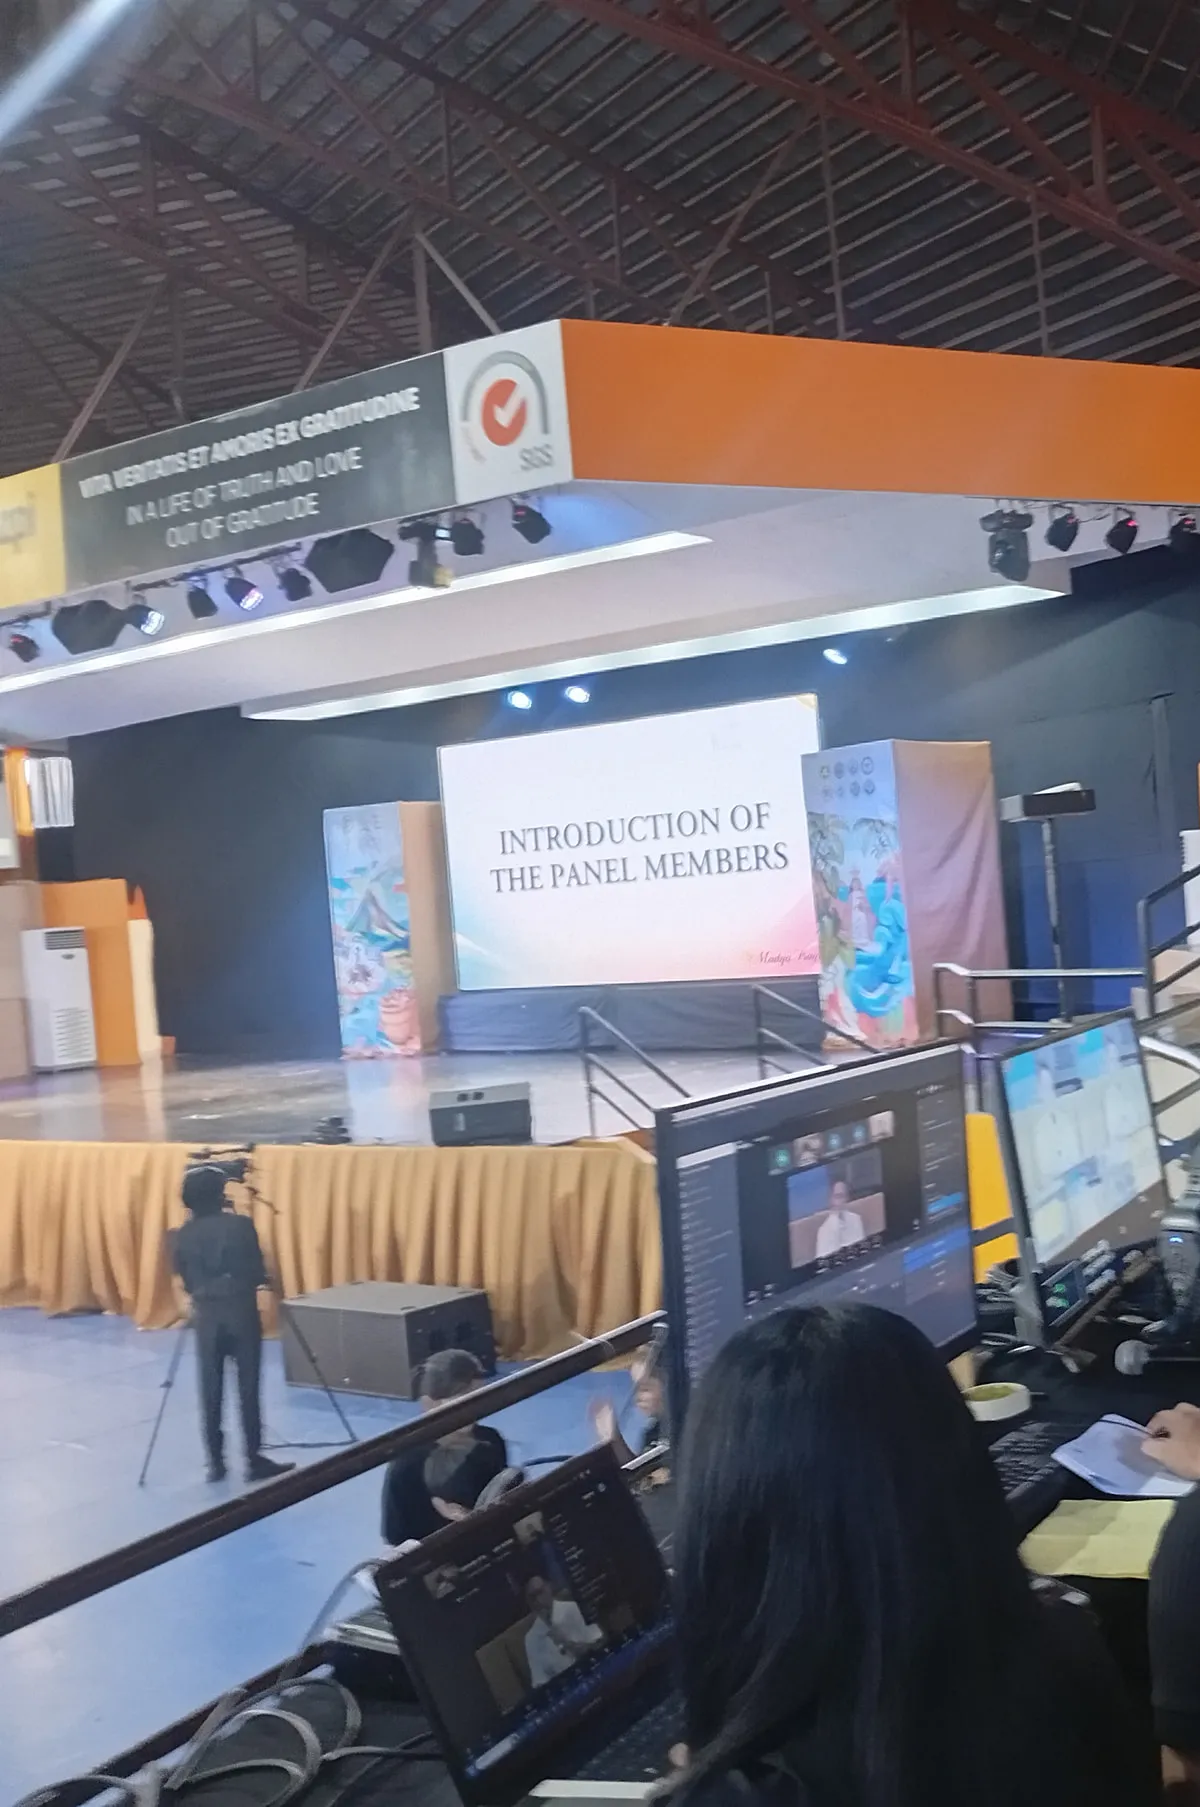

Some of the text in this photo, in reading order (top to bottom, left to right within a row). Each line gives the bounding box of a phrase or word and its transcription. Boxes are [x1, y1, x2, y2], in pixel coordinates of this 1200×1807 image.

[79, 473, 114, 498] VITA
[188, 445, 210, 469] ET
[210, 428, 275, 463] AMORIS
[275, 420, 301, 446] EX
[300, 387, 421, 438] GRATITUDINE
[519, 443, 554, 471] SGS
[125, 446, 364, 526] IN A LIFE OF TRUTH AND LOVE
[166, 492, 320, 547] OUT OF GRATITUDE
[500, 801, 770, 855] INTRODUCTION OF
[490, 841, 789, 893] THE PANEL MEMBERS
